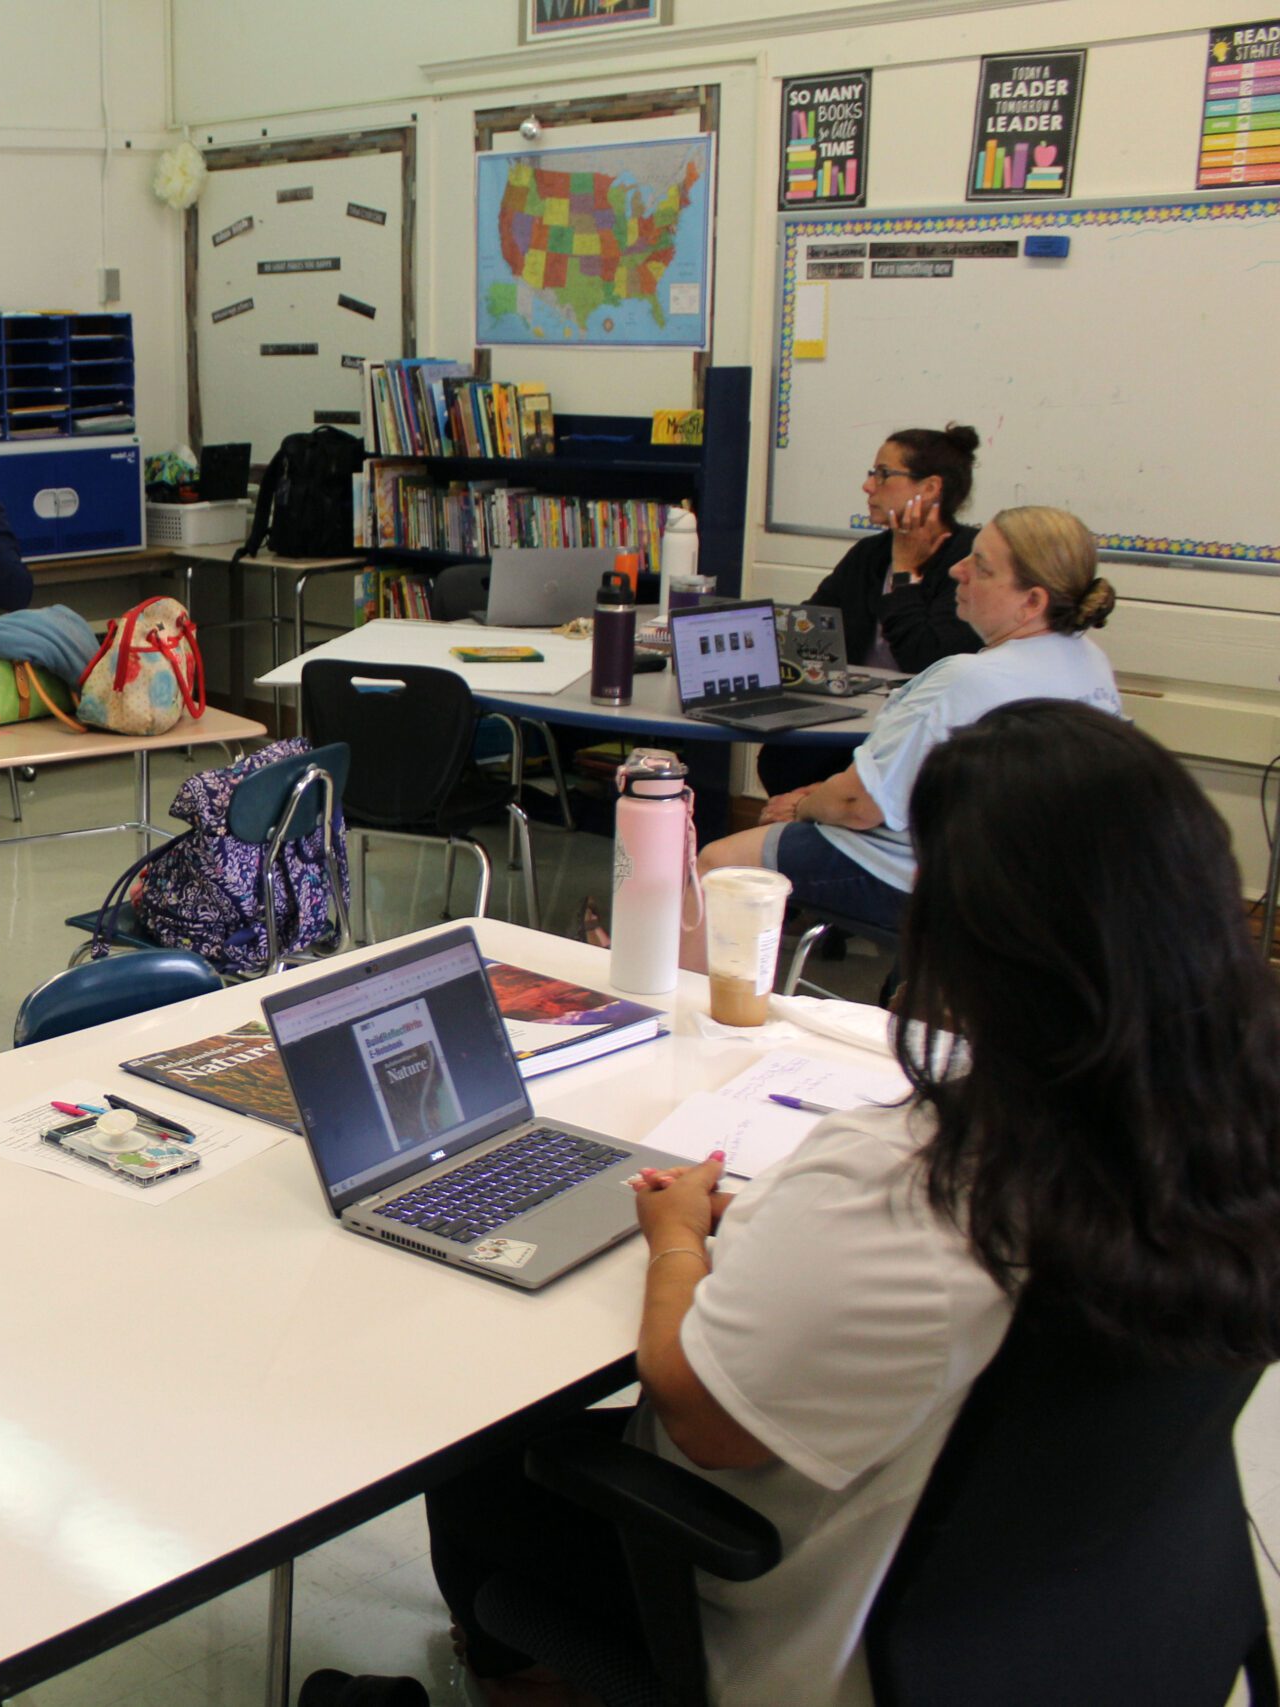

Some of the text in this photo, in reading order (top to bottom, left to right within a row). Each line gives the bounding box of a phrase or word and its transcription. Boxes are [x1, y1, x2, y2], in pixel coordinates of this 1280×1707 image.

[1012, 65, 1050, 81] TODAY A
[789, 84, 863, 106] SO MANY
[989, 79, 1069, 99] READER
[817, 102, 863, 122] BOOKS
[995, 99, 1059, 114] TOMORROW A
[986, 114, 1063, 133] LEADER
[819, 140, 855, 157] TIME
[916, 243, 934, 255] the
[156, 1043, 228, 1071] Relationships
[230, 1041, 245, 1050] in
[168, 1042, 276, 1082] Nature
[386, 1057, 428, 1084] Nature
[431, 1149, 447, 1161] DELL
